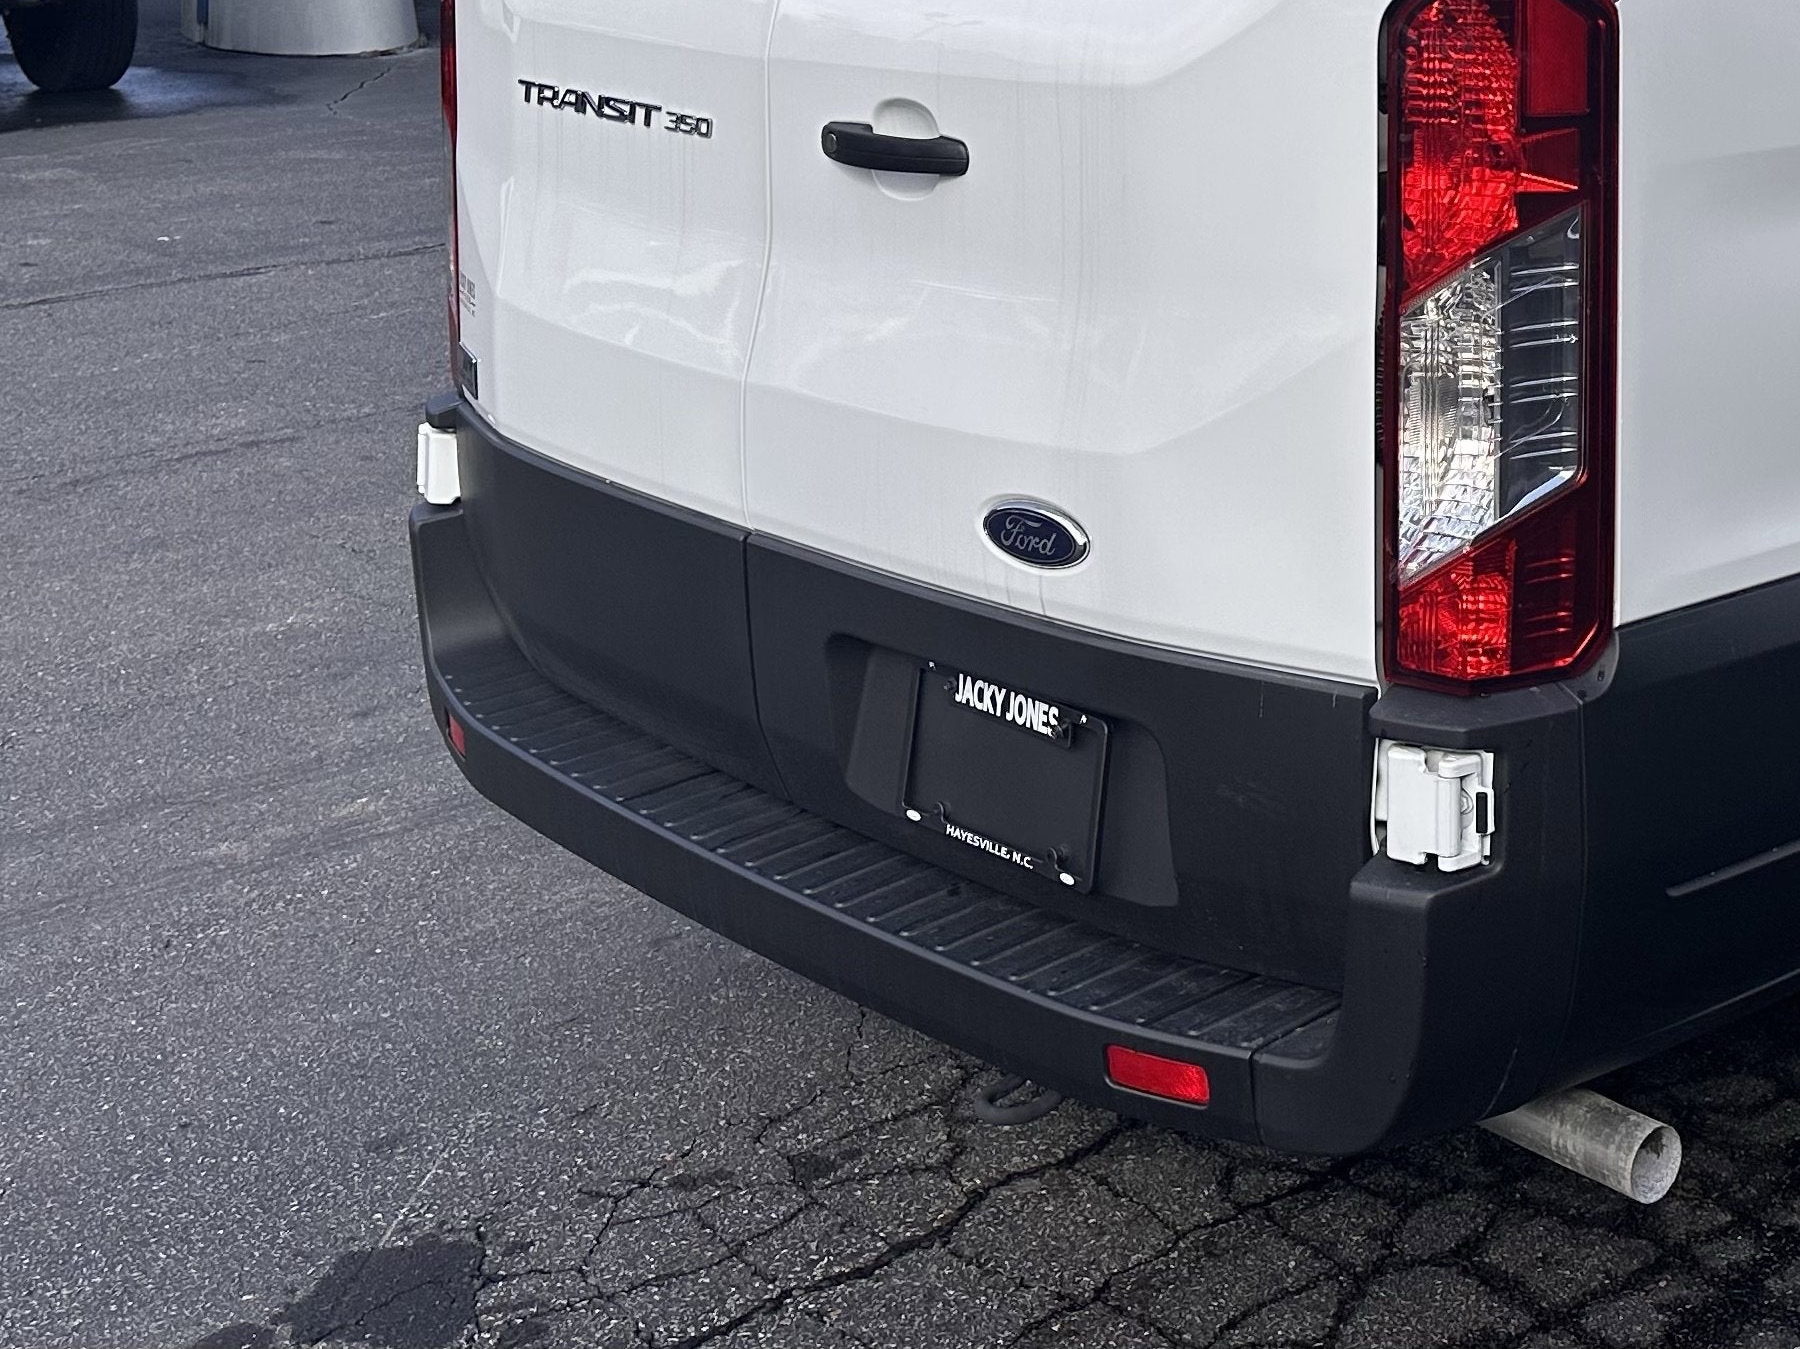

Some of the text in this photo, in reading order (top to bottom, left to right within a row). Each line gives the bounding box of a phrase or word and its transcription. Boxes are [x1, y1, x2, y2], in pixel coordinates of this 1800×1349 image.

[517, 78, 714, 139] TRANSIT 350
[1000, 514, 1057, 556] Ford
[955, 673, 1060, 738] JACKY JONES
